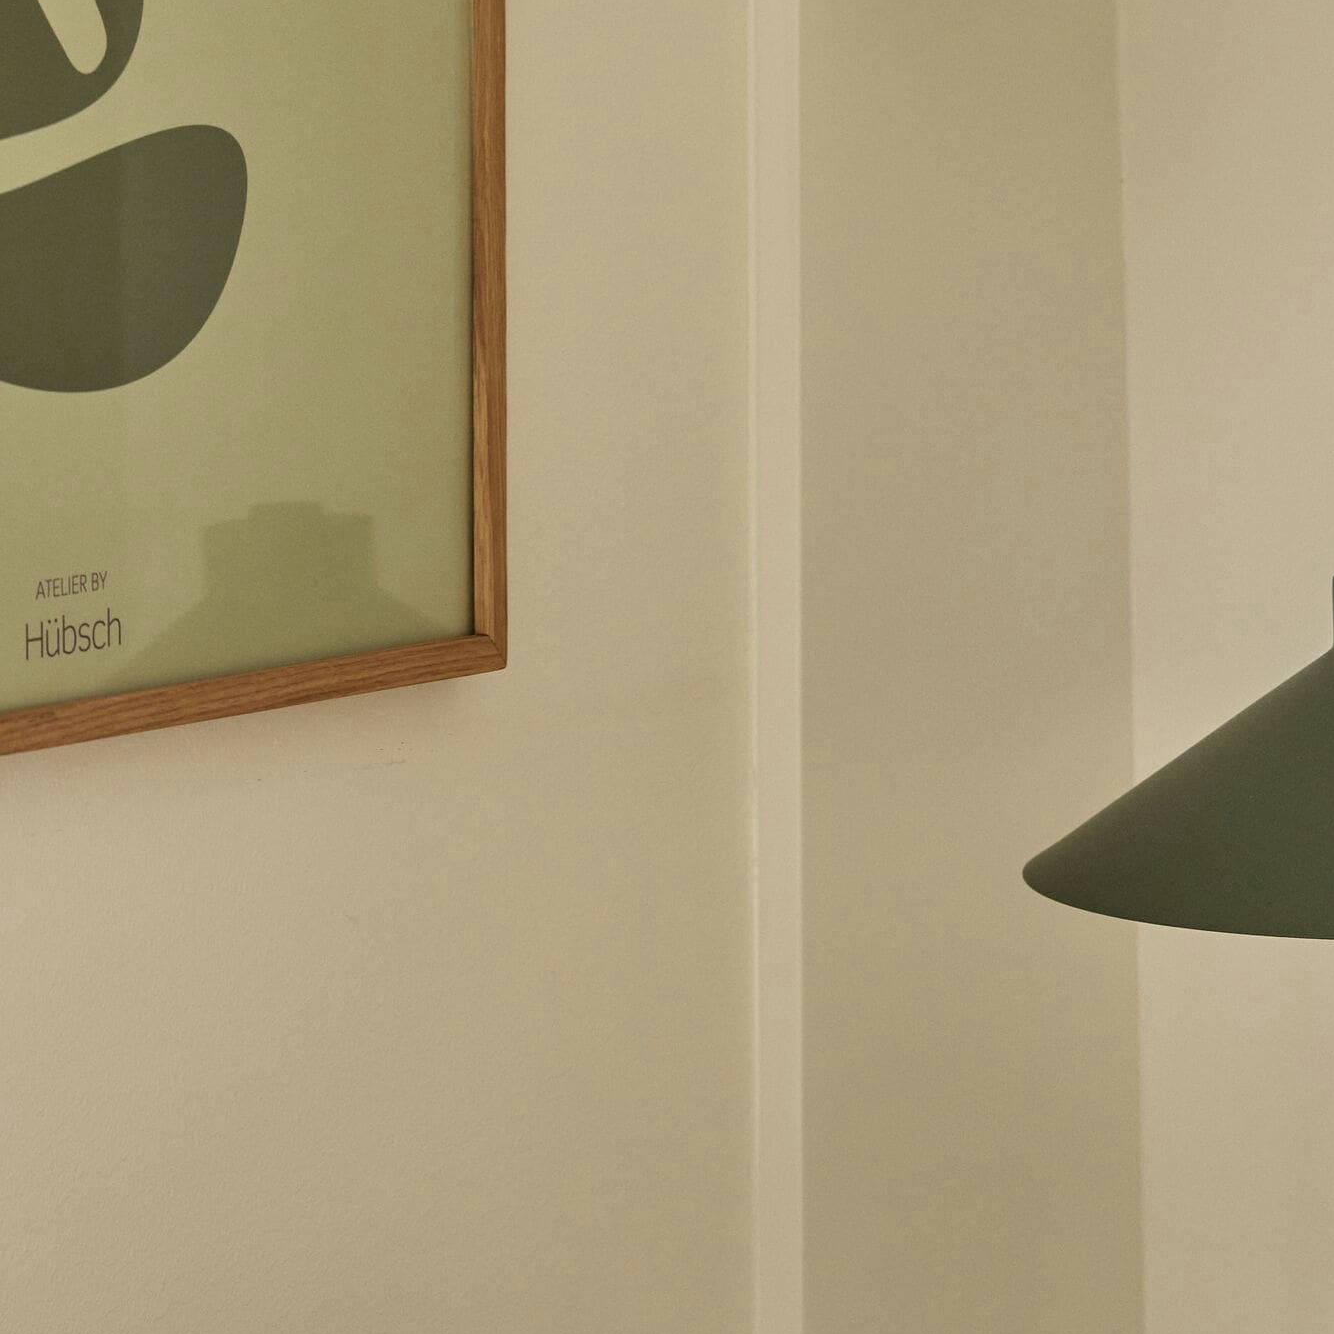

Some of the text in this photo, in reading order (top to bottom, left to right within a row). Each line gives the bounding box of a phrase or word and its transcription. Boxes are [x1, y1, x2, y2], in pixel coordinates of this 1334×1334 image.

[35, 570, 109, 601] ATELIER BY
[25, 606, 122, 661] Hübsch
